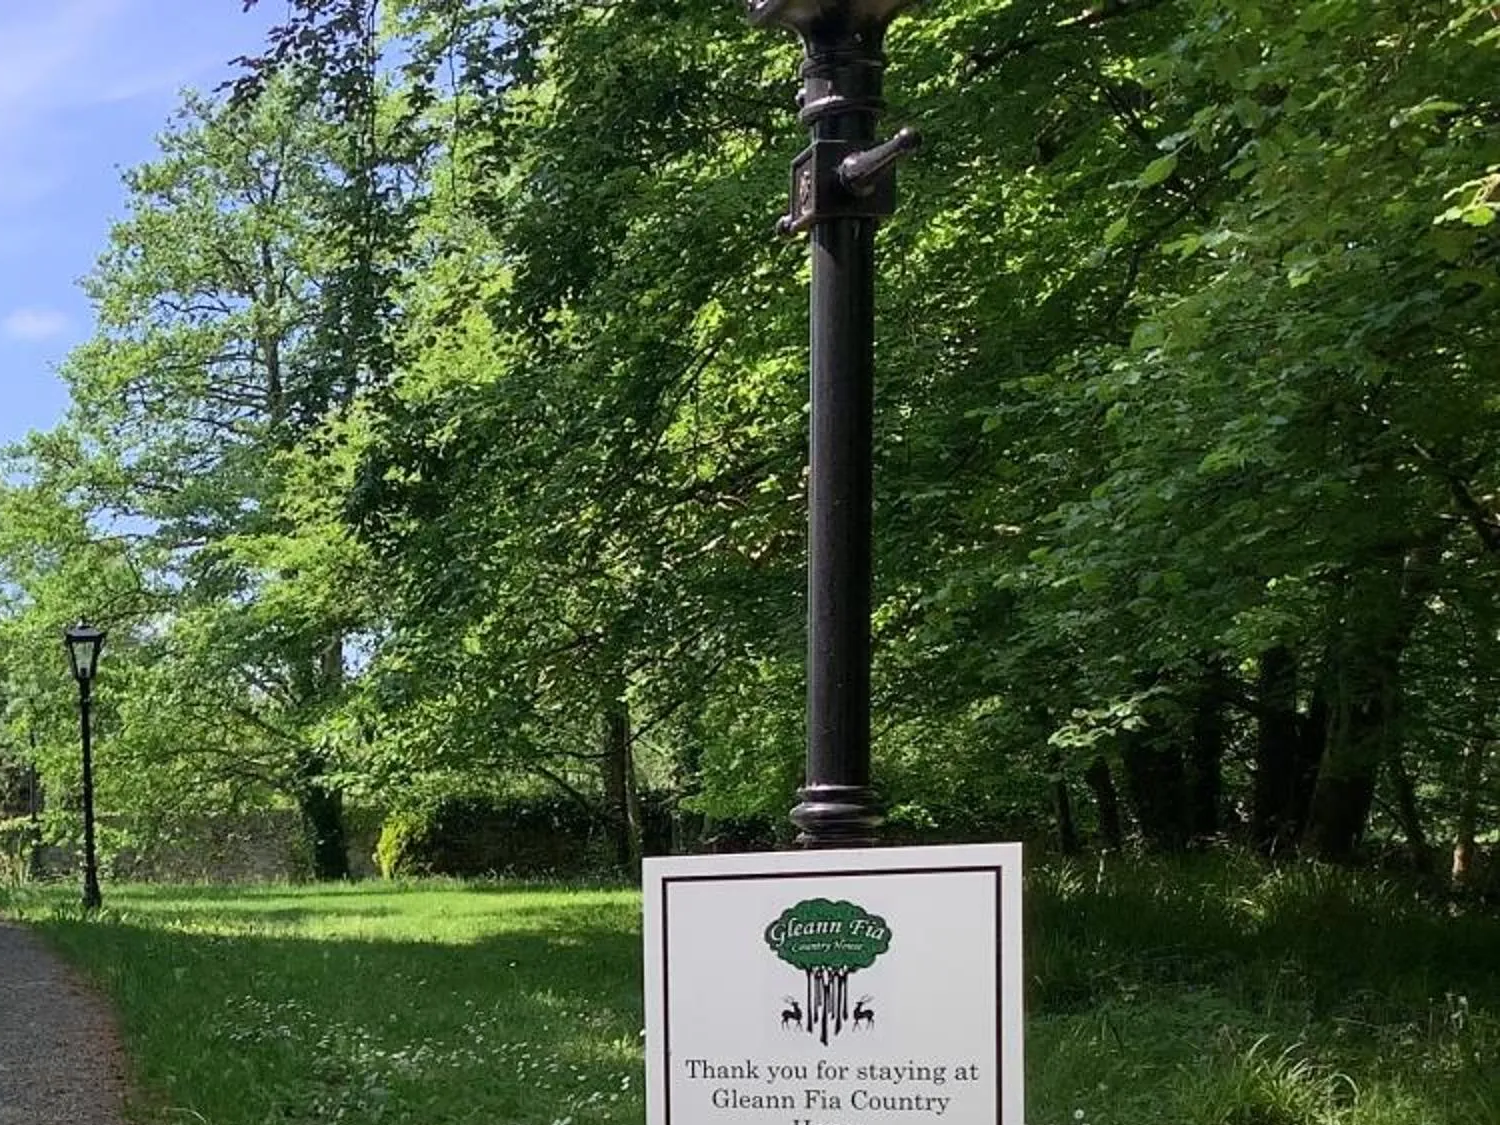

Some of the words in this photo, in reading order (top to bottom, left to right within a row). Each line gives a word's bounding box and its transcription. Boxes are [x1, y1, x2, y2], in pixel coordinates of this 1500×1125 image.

[770, 917, 842, 947] Gleann
[849, 918, 887, 940] Fia
[685, 1059, 760, 1081] Thank
[766, 1065, 807, 1085] you
[817, 1060, 849, 1081] for
[857, 1060, 947, 1085] staying
[954, 1064, 979, 1081] at
[712, 1089, 795, 1109] Gleann
[804, 1090, 841, 1110] Fia
[850, 1090, 950, 1115] Country
